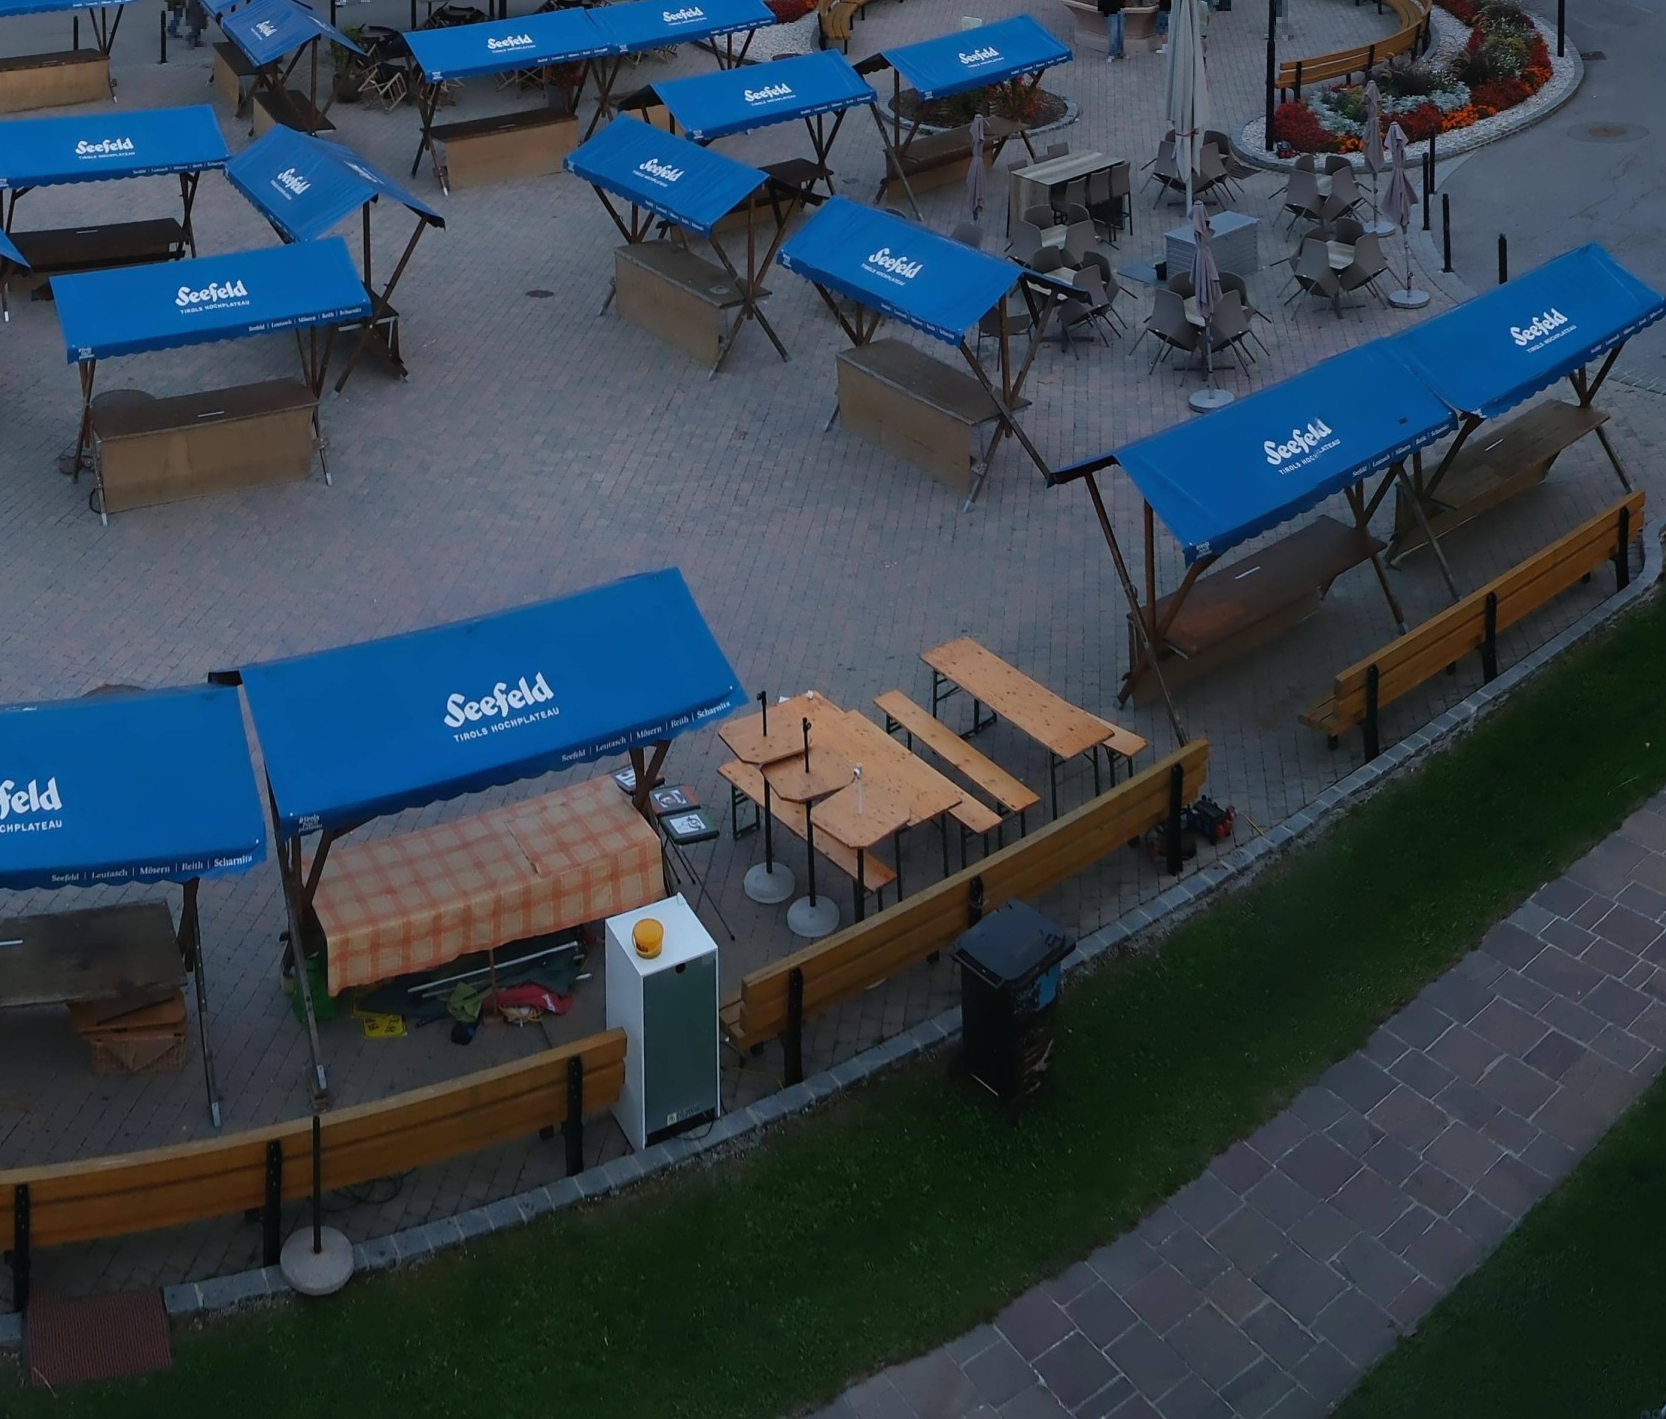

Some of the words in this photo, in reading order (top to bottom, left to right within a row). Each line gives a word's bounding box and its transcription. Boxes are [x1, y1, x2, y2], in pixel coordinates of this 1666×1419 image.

[663, 7, 704, 22] Seefeld
[487, 34, 534, 50] Seefeld
[959, 46, 1000, 65] Seefeld
[744, 83, 792, 103] Seefeld
[75, 137, 135, 155] Seefeld
[640, 158, 684, 182] Seefeld
[868, 248, 923, 279] Seefeld
[175, 279, 248, 306] Seefeld
[1510, 308, 1568, 346] Seefeld
[1263, 417, 1333, 467] Seefeld
[443, 671, 554, 728] Seefeld
[453, 727, 488, 742] TIROLS
[491, 707, 560, 733] HOCHPLATEAU
[561, 747, 586, 763] Seefeld
[595, 736, 626, 752] Leutasch
[636, 724, 662, 740] Mösern
[670, 715, 689, 728] Reith
[696, 701, 731, 719] Scharnitz
[52, 872, 80, 882] Seefeld
[91, 868, 128, 879] Leutasch
[139, 865, 170, 875] Mösern
[182, 860, 203, 871] Reith
[214, 854, 253, 868] Scharnitz
